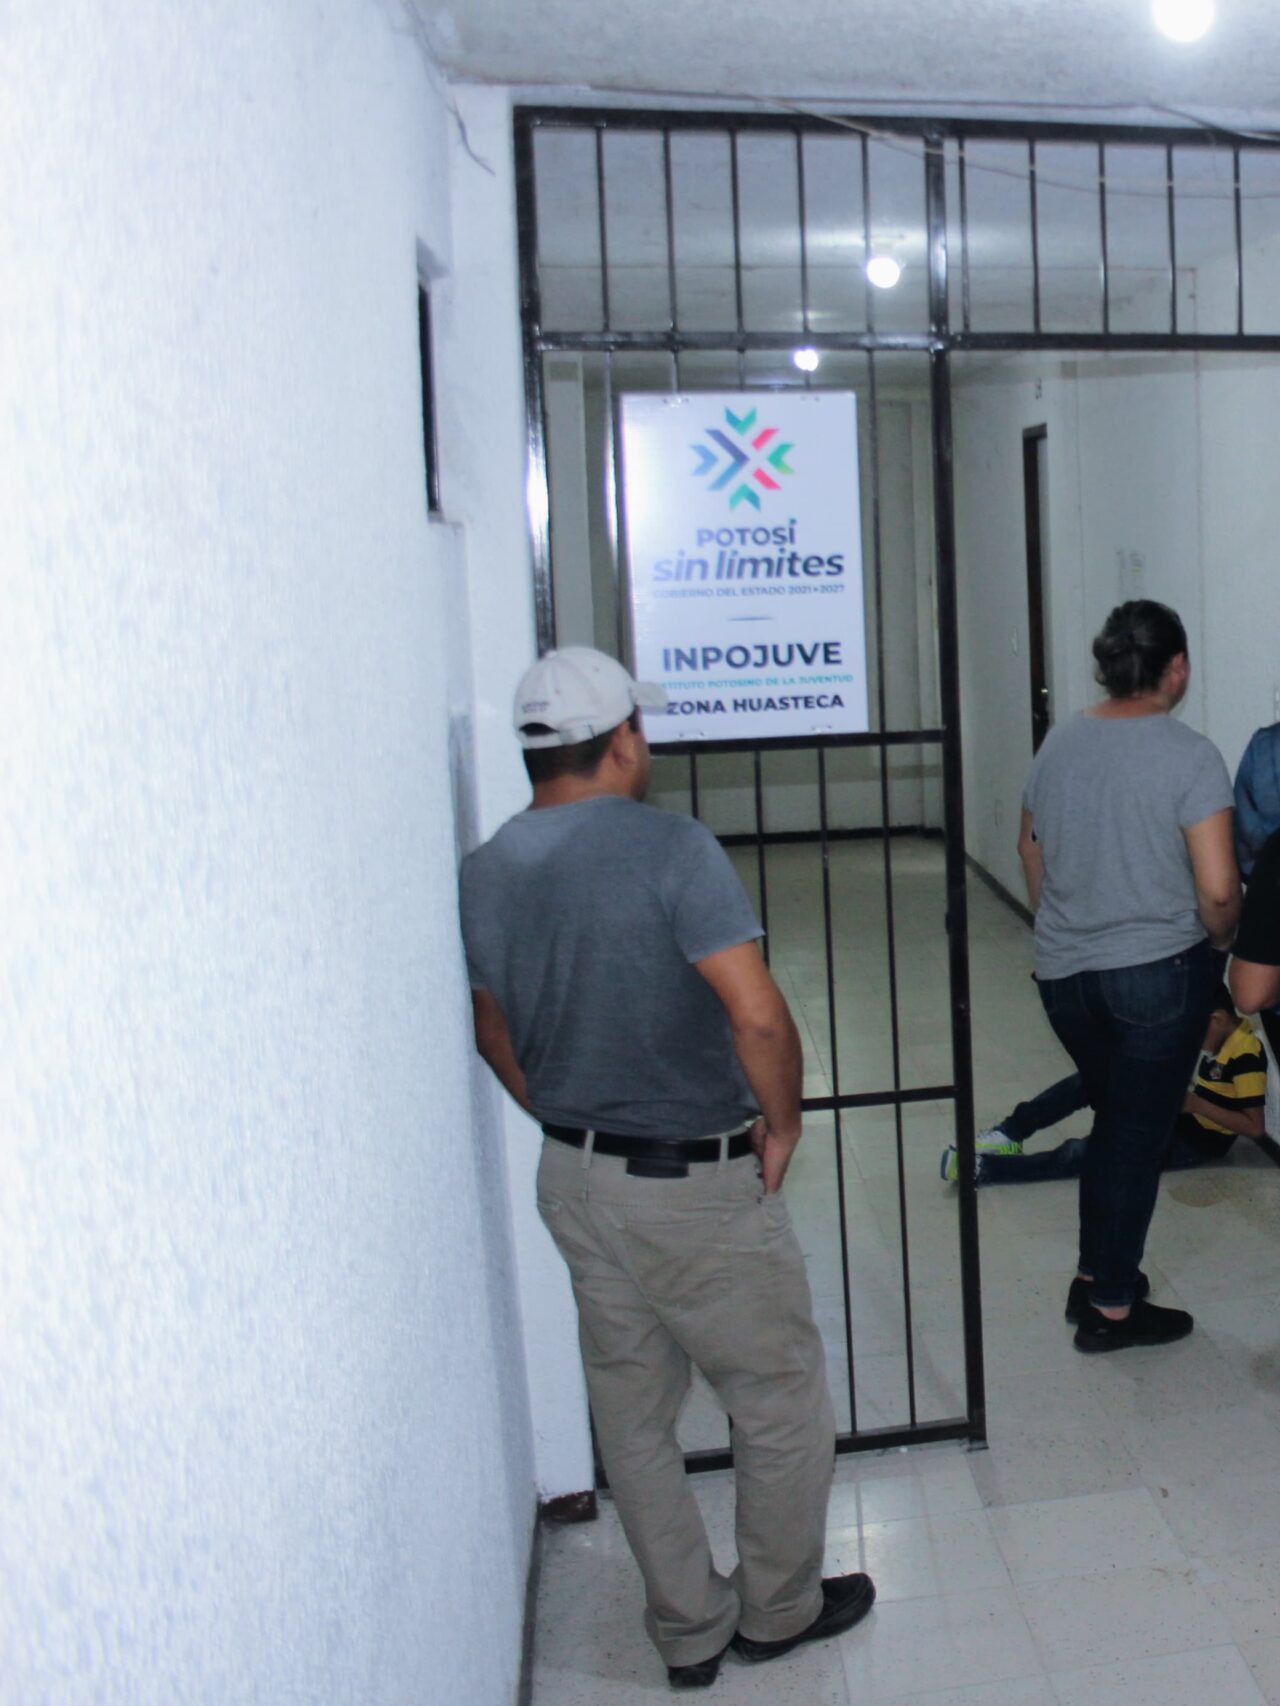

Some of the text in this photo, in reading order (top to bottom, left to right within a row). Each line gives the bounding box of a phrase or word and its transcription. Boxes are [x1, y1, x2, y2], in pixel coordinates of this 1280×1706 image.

[697, 517, 797, 546] POTOSÍ
[653, 550, 709, 582] sin
[716, 586, 738, 597] DEL
[742, 585, 785, 596] ESTADO
[662, 641, 842, 672] INPOJUVE
[708, 678, 762, 689] POTOSINO
[766, 677, 778, 686] DE
[782, 676, 796, 685] LA
[800, 674, 853, 684] JUVENTUD
[666, 695, 845, 716] ZONA HUASTECA
